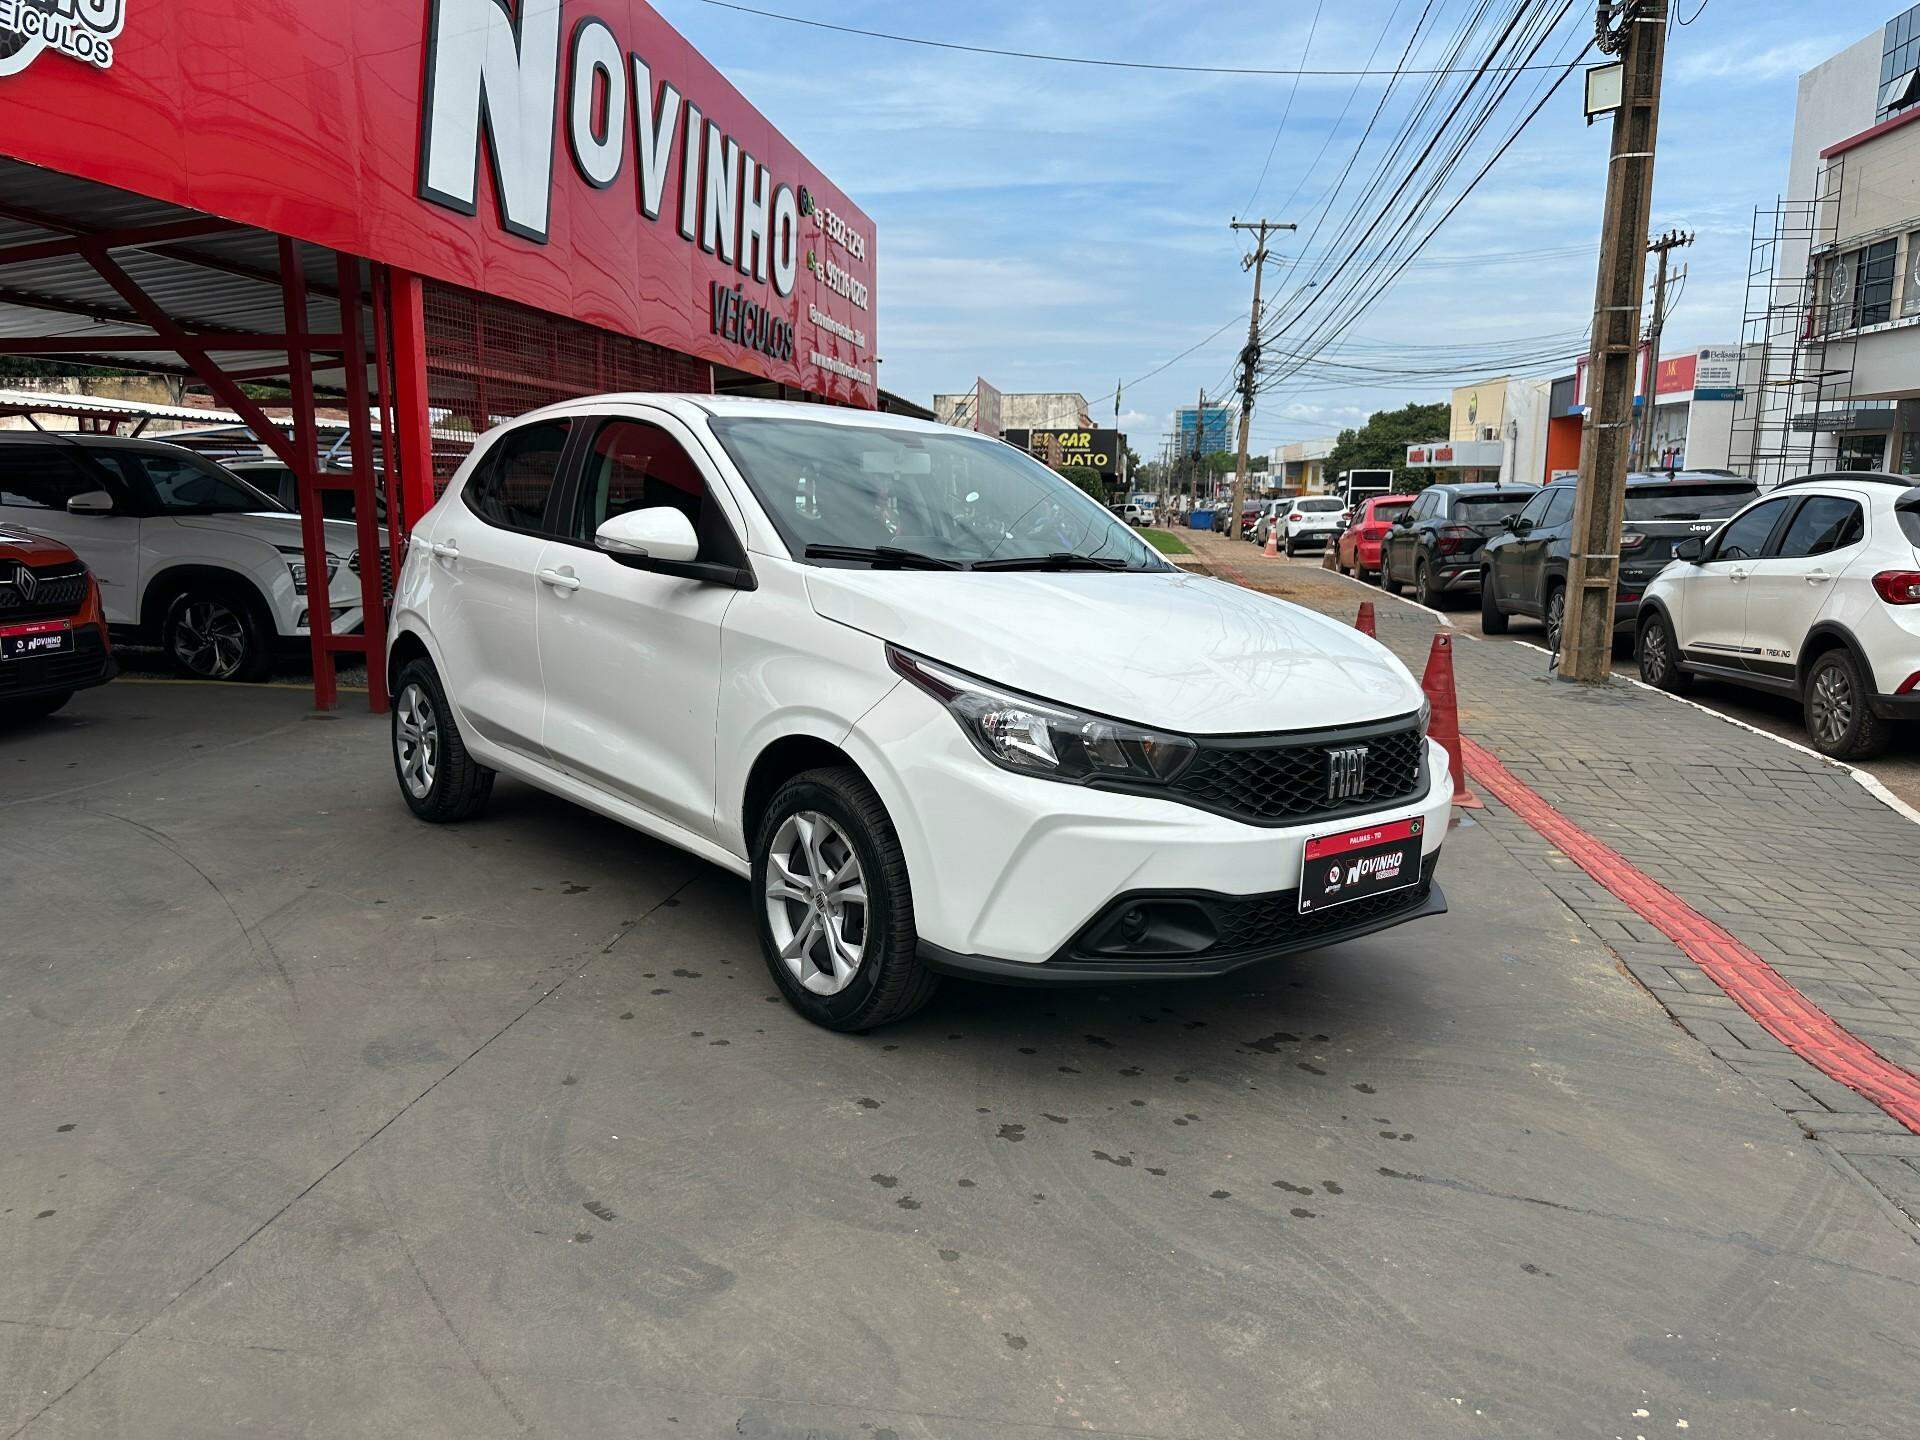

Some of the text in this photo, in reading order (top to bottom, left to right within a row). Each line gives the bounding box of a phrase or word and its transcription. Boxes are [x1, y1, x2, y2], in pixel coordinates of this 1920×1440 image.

[418, 0, 798, 297] NOVINHO
[825, 208, 865, 262] 3322-1254
[710, 281, 793, 362] VEÍCULOS
[1058, 432, 1091, 448] CAR
[1062, 453, 1108, 466] JATO
[1689, 524, 1712, 532] Jeep
[28, 636, 61, 650] NOVINHO
[1328, 747, 1369, 800] FIAT
[1349, 834, 1371, 845] PALMAS
[1373, 832, 1382, 840] TO
[1345, 852, 1403, 885] NOVINHO
[1302, 900, 1311, 908] BR
